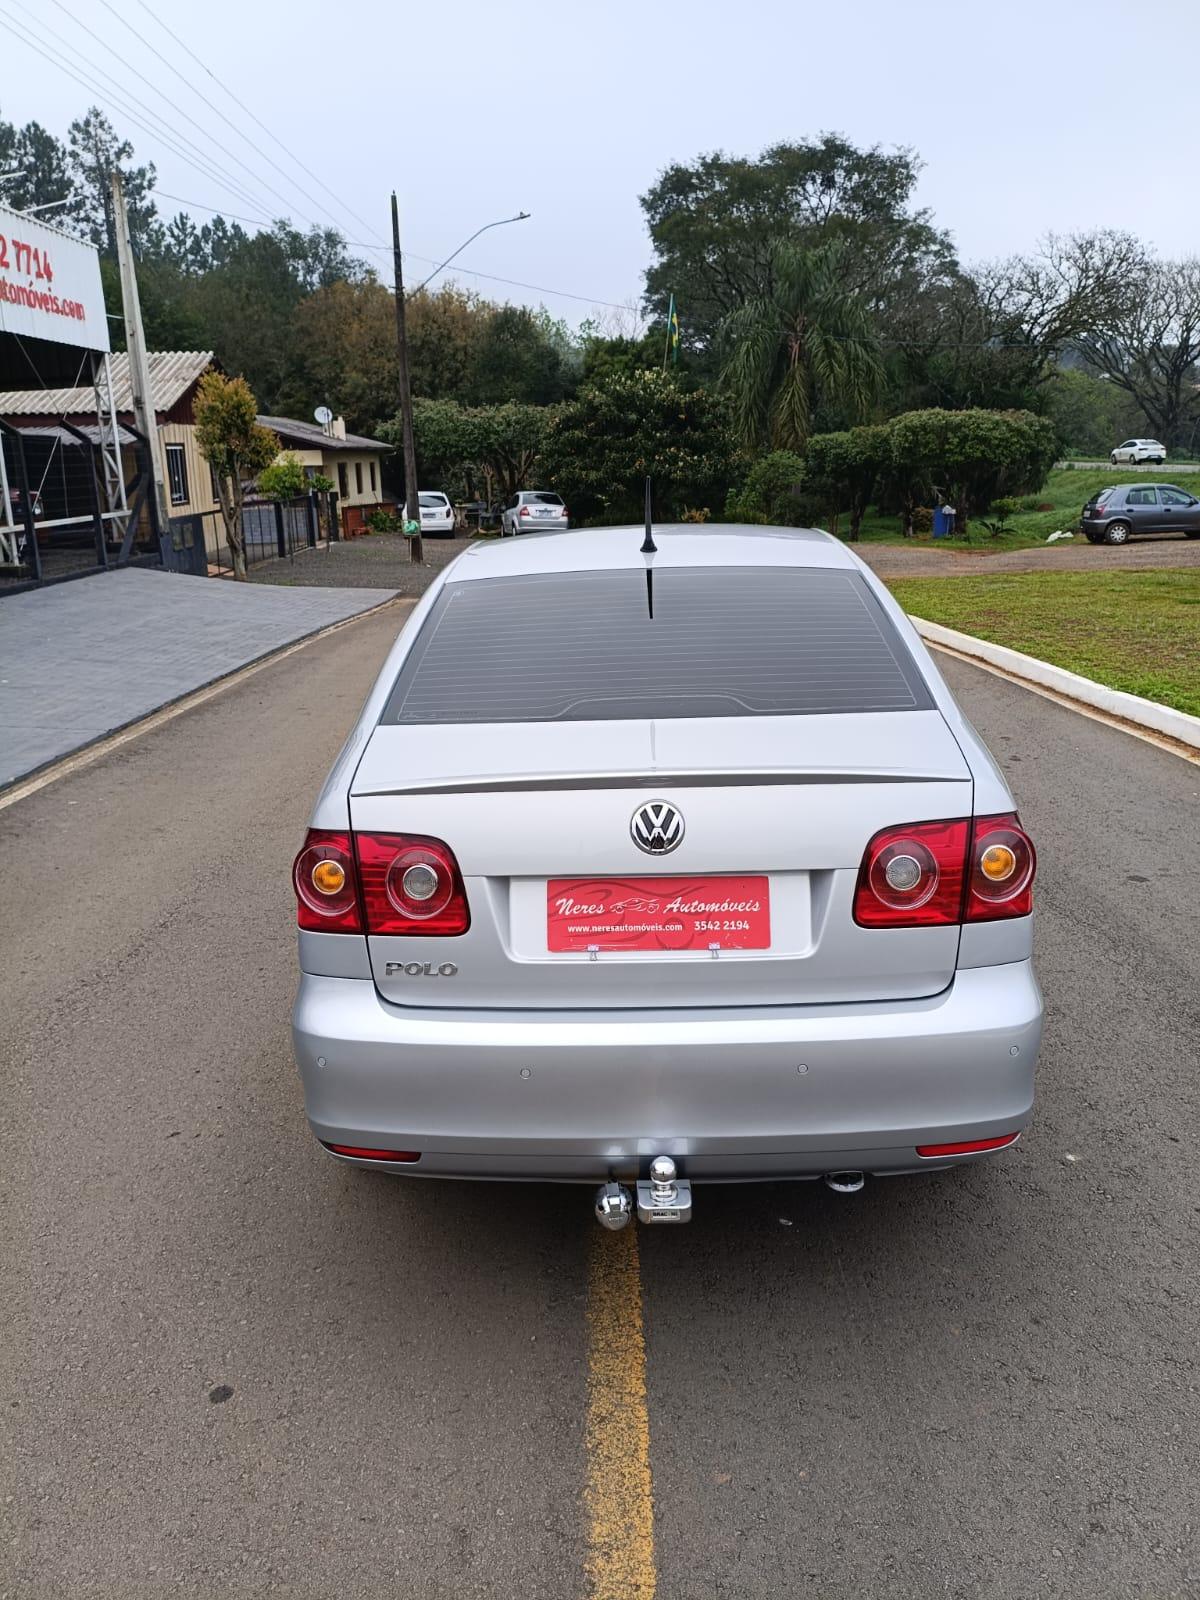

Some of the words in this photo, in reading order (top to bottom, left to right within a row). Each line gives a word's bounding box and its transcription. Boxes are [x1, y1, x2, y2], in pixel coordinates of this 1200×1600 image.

[12, 239, 53, 282] 7714
[556, 898, 605, 915] Neres
[663, 897, 760, 914] Automóveis
[567, 923, 683, 933] www.neresautomóveis.com
[694, 920, 721, 931] 3542
[723, 920, 750, 931] 2194
[385, 960, 459, 976] POLO
